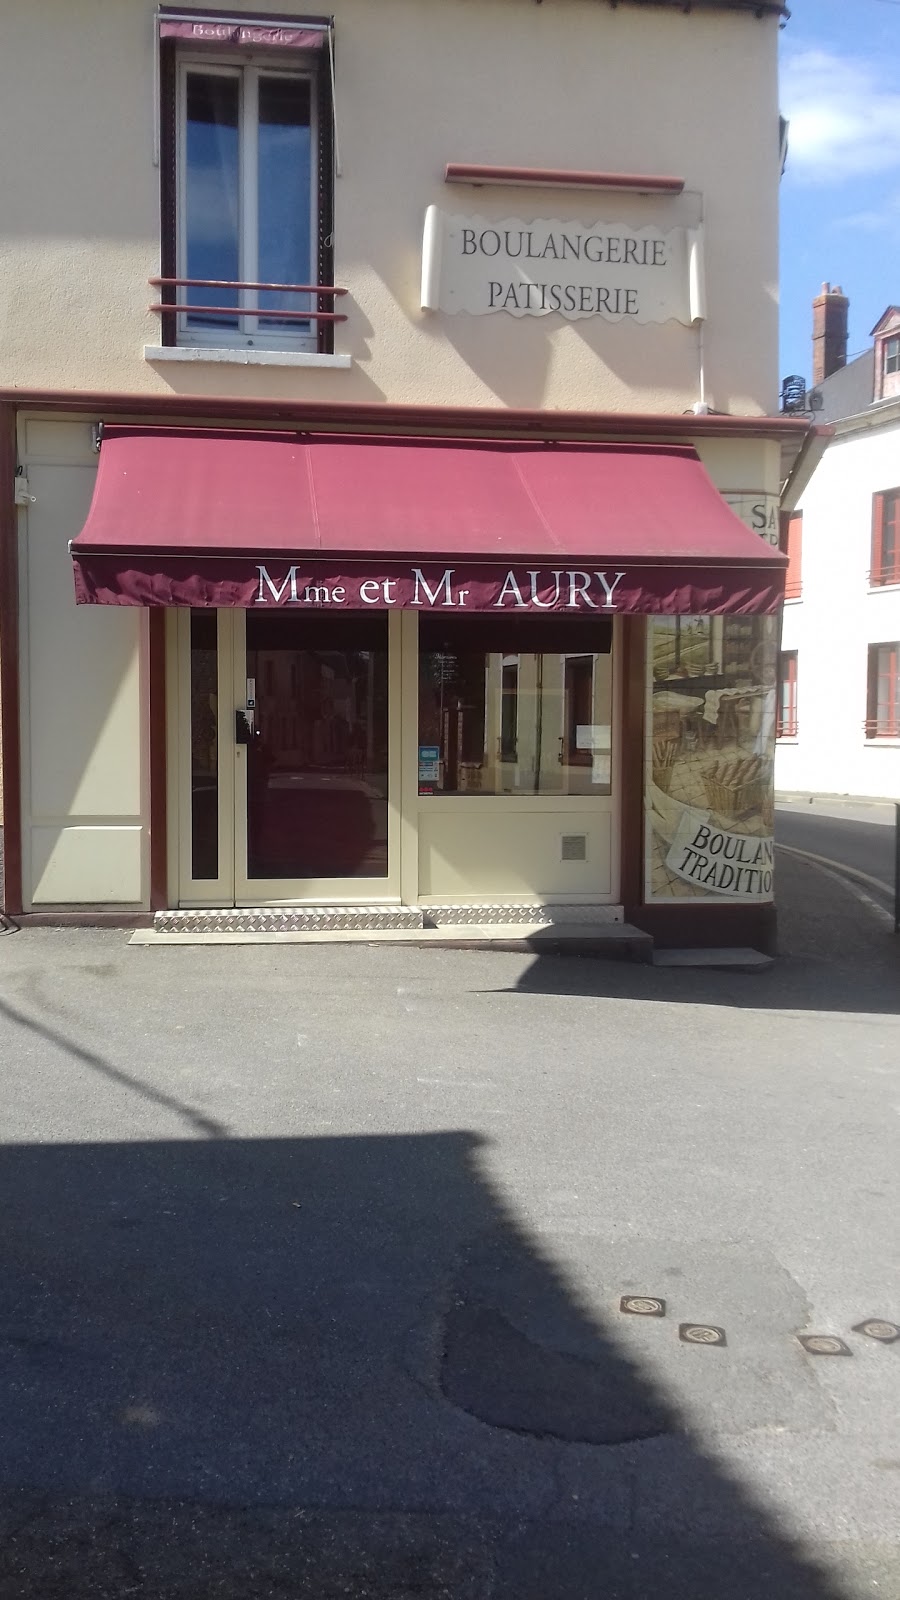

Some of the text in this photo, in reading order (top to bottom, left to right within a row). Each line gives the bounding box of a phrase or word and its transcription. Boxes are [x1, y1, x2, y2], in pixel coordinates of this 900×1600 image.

[461, 229, 667, 266] BOULANGERIE
[488, 281, 640, 315] PATISSERIE
[752, 504, 780, 529] SA
[255, 565, 626, 608] Mme et Mr AURY
